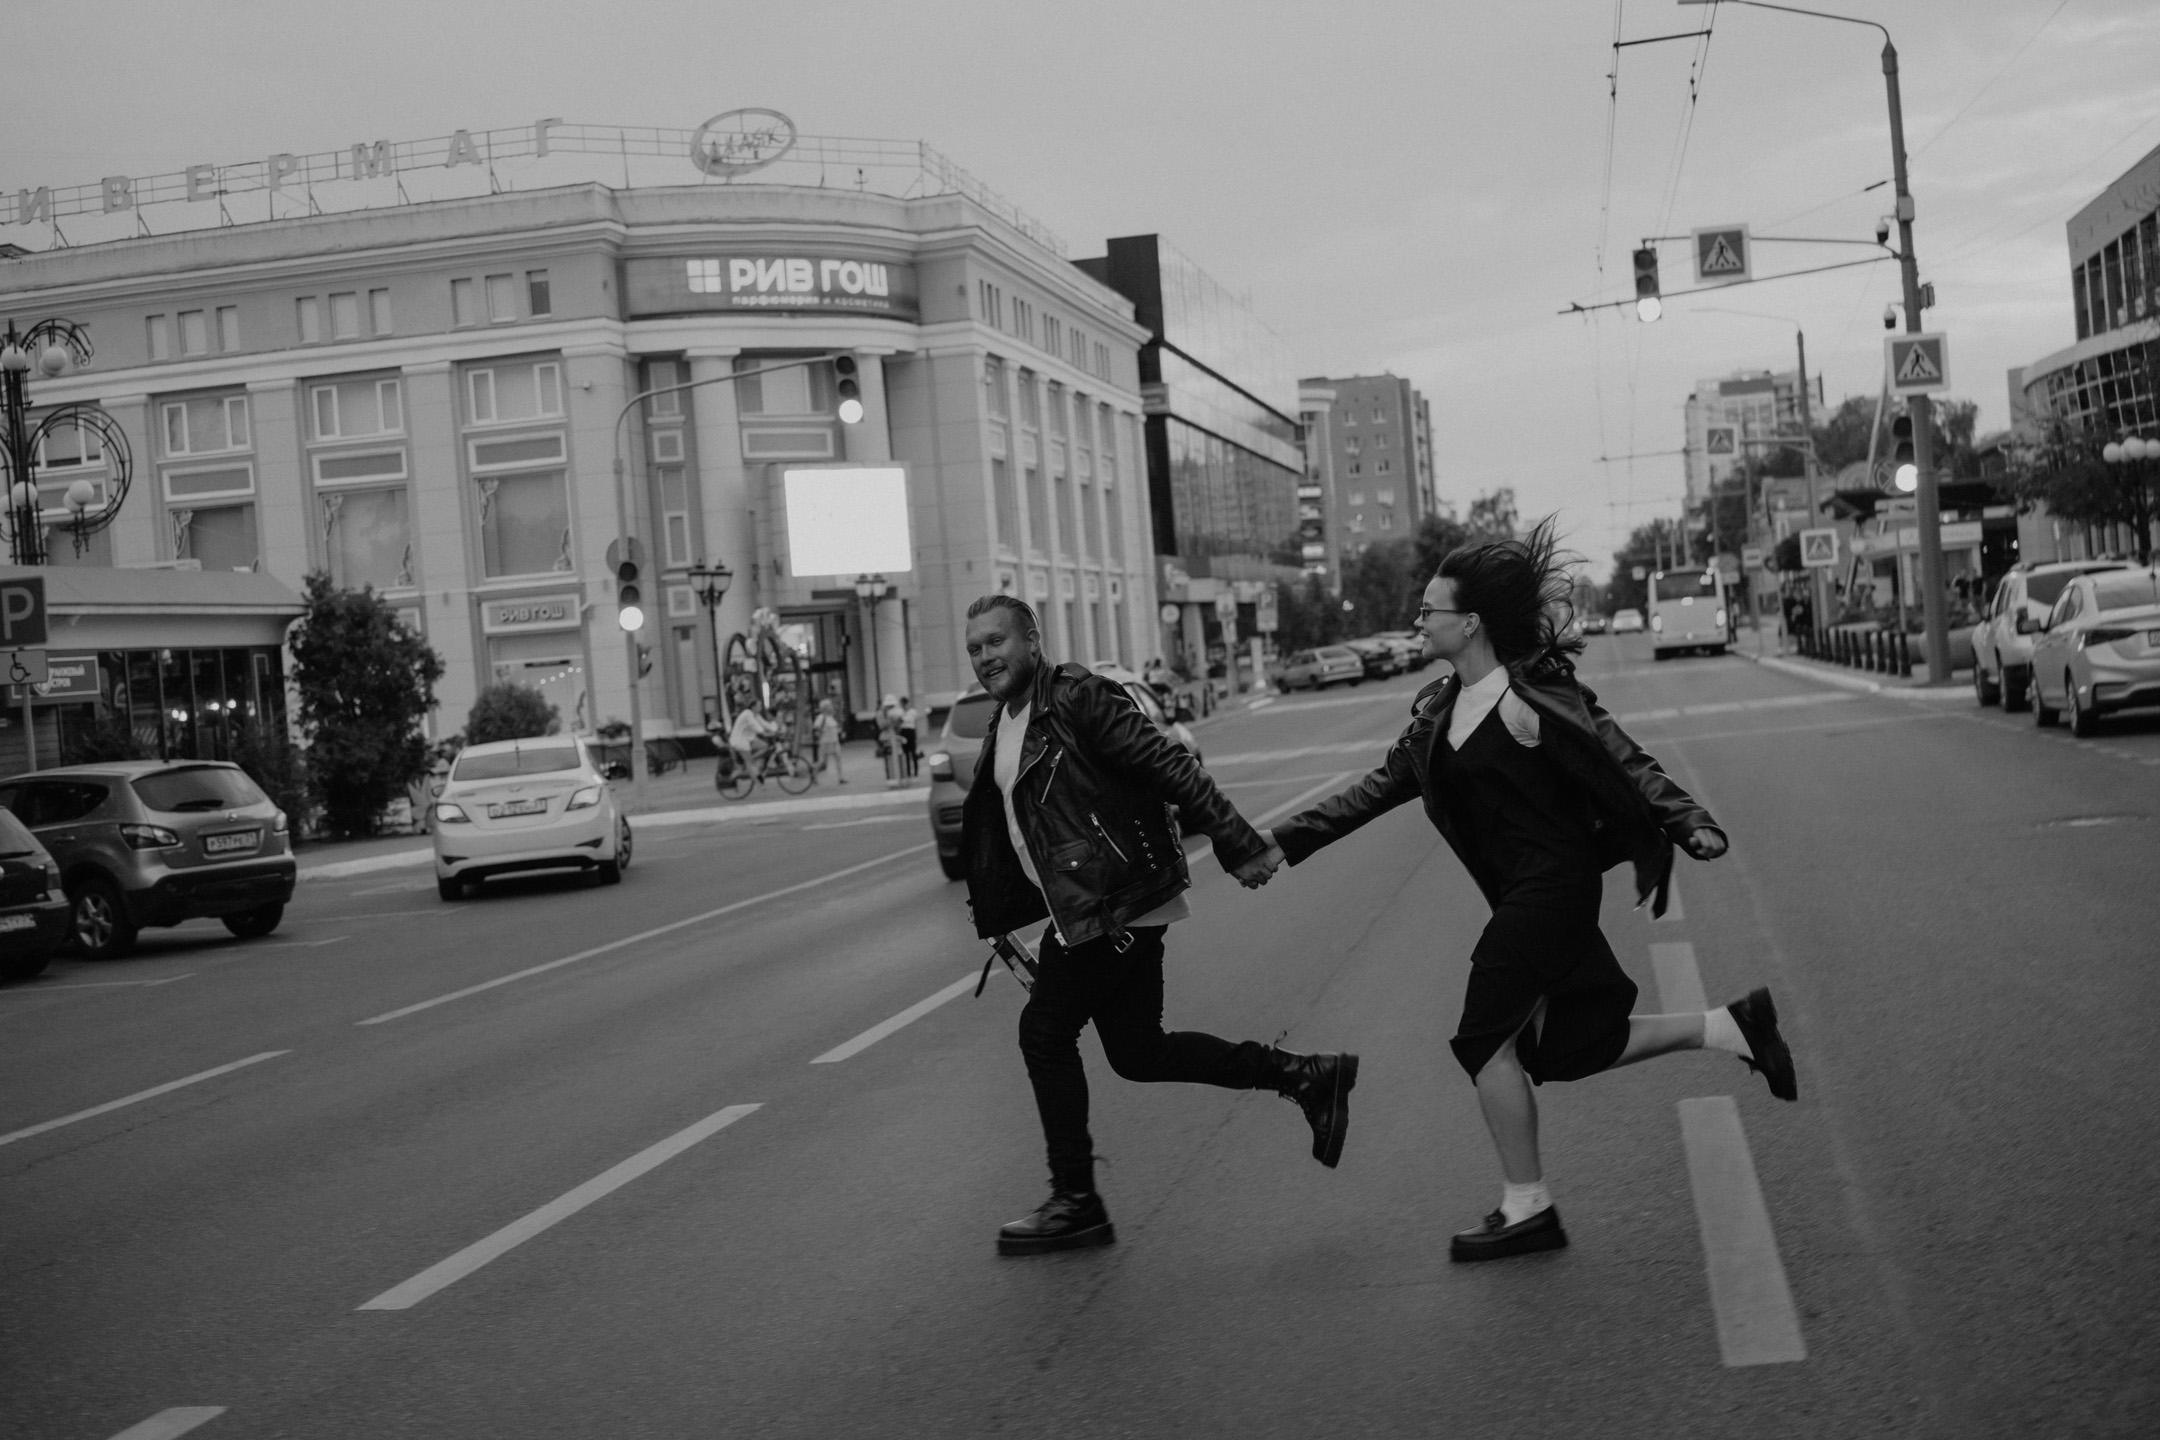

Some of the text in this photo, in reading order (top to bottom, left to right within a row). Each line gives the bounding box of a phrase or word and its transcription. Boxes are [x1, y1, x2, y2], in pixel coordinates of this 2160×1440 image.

[729, 258, 889, 296] РИВ ГОШ
[1, 586, 35, 640] P
[500, 604, 565, 623] РИВ ГОШ
